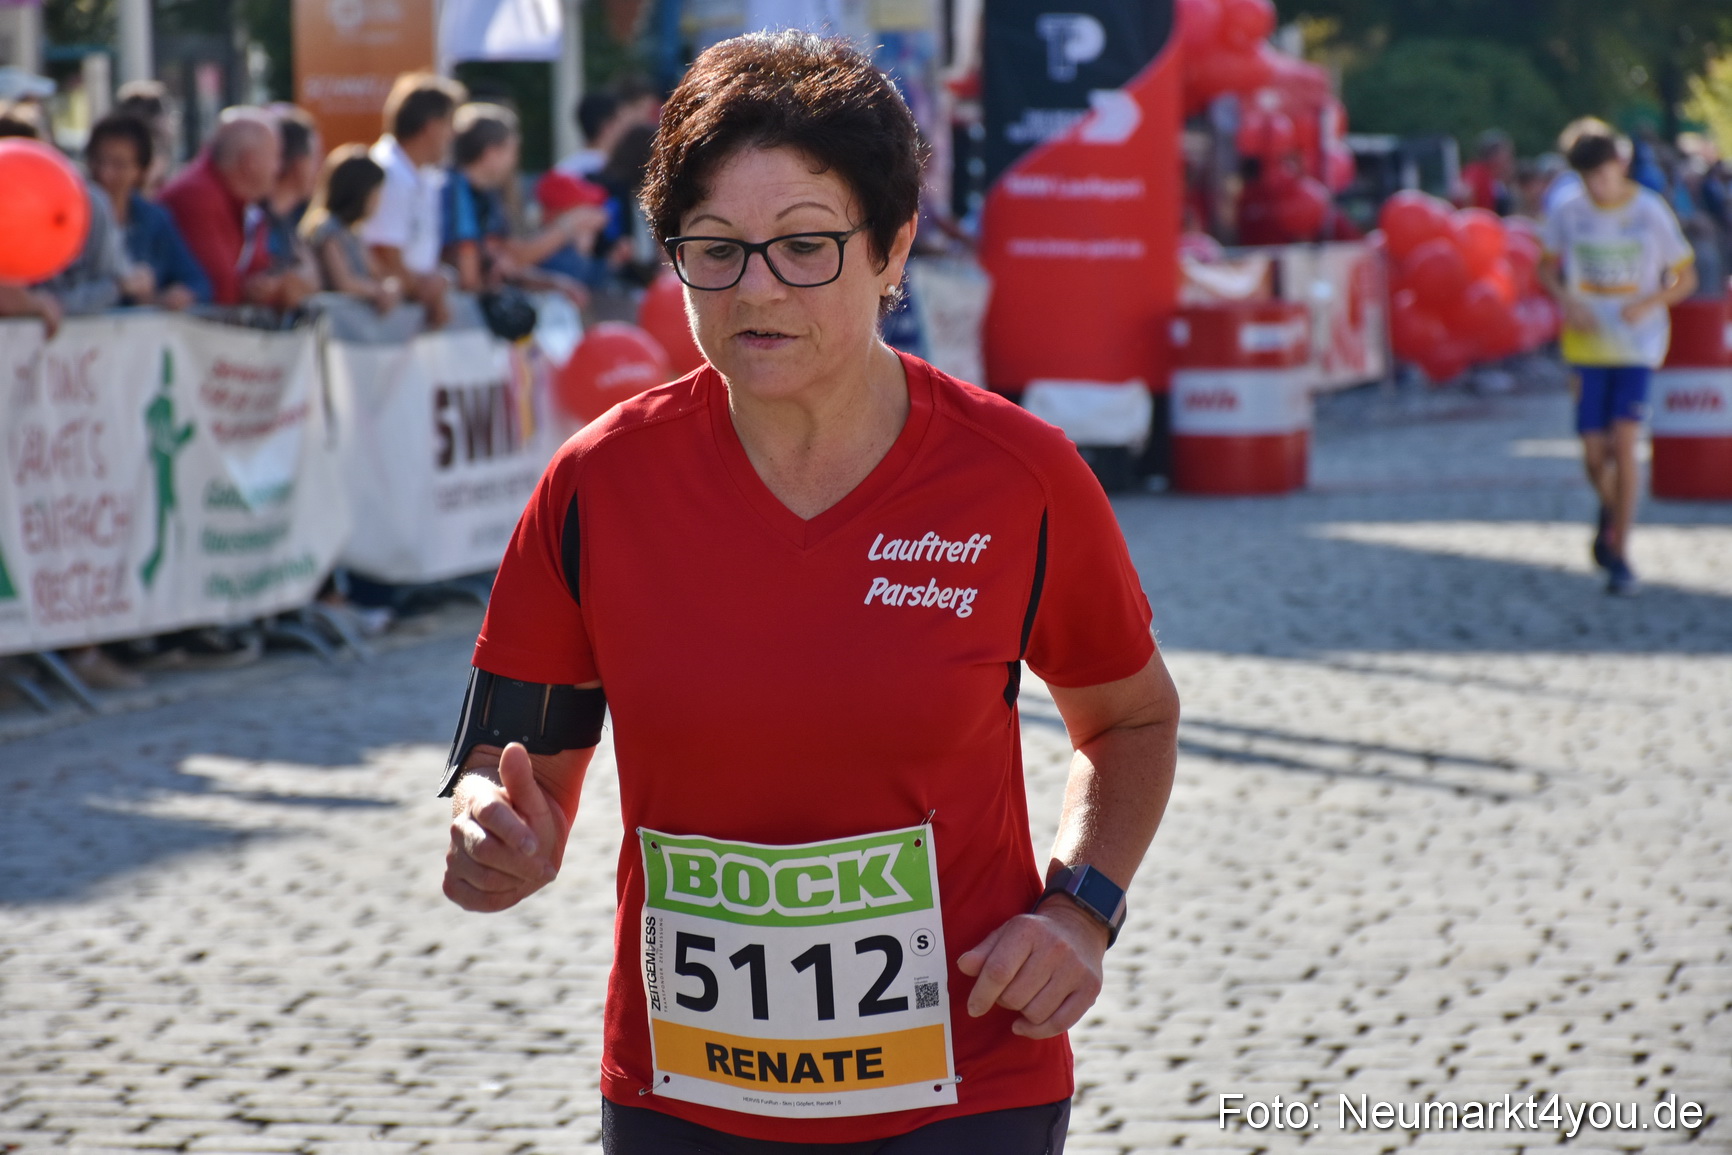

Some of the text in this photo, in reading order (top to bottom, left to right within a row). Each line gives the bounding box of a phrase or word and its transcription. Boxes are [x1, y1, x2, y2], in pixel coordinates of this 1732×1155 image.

[867, 531, 992, 564] Lauftreff
[863, 577, 978, 618] Parsberg
[666, 849, 901, 911] BOCK
[917, 935, 929, 950] S
[674, 930, 909, 1021] 5112
[705, 1041, 885, 1084] RENATE
